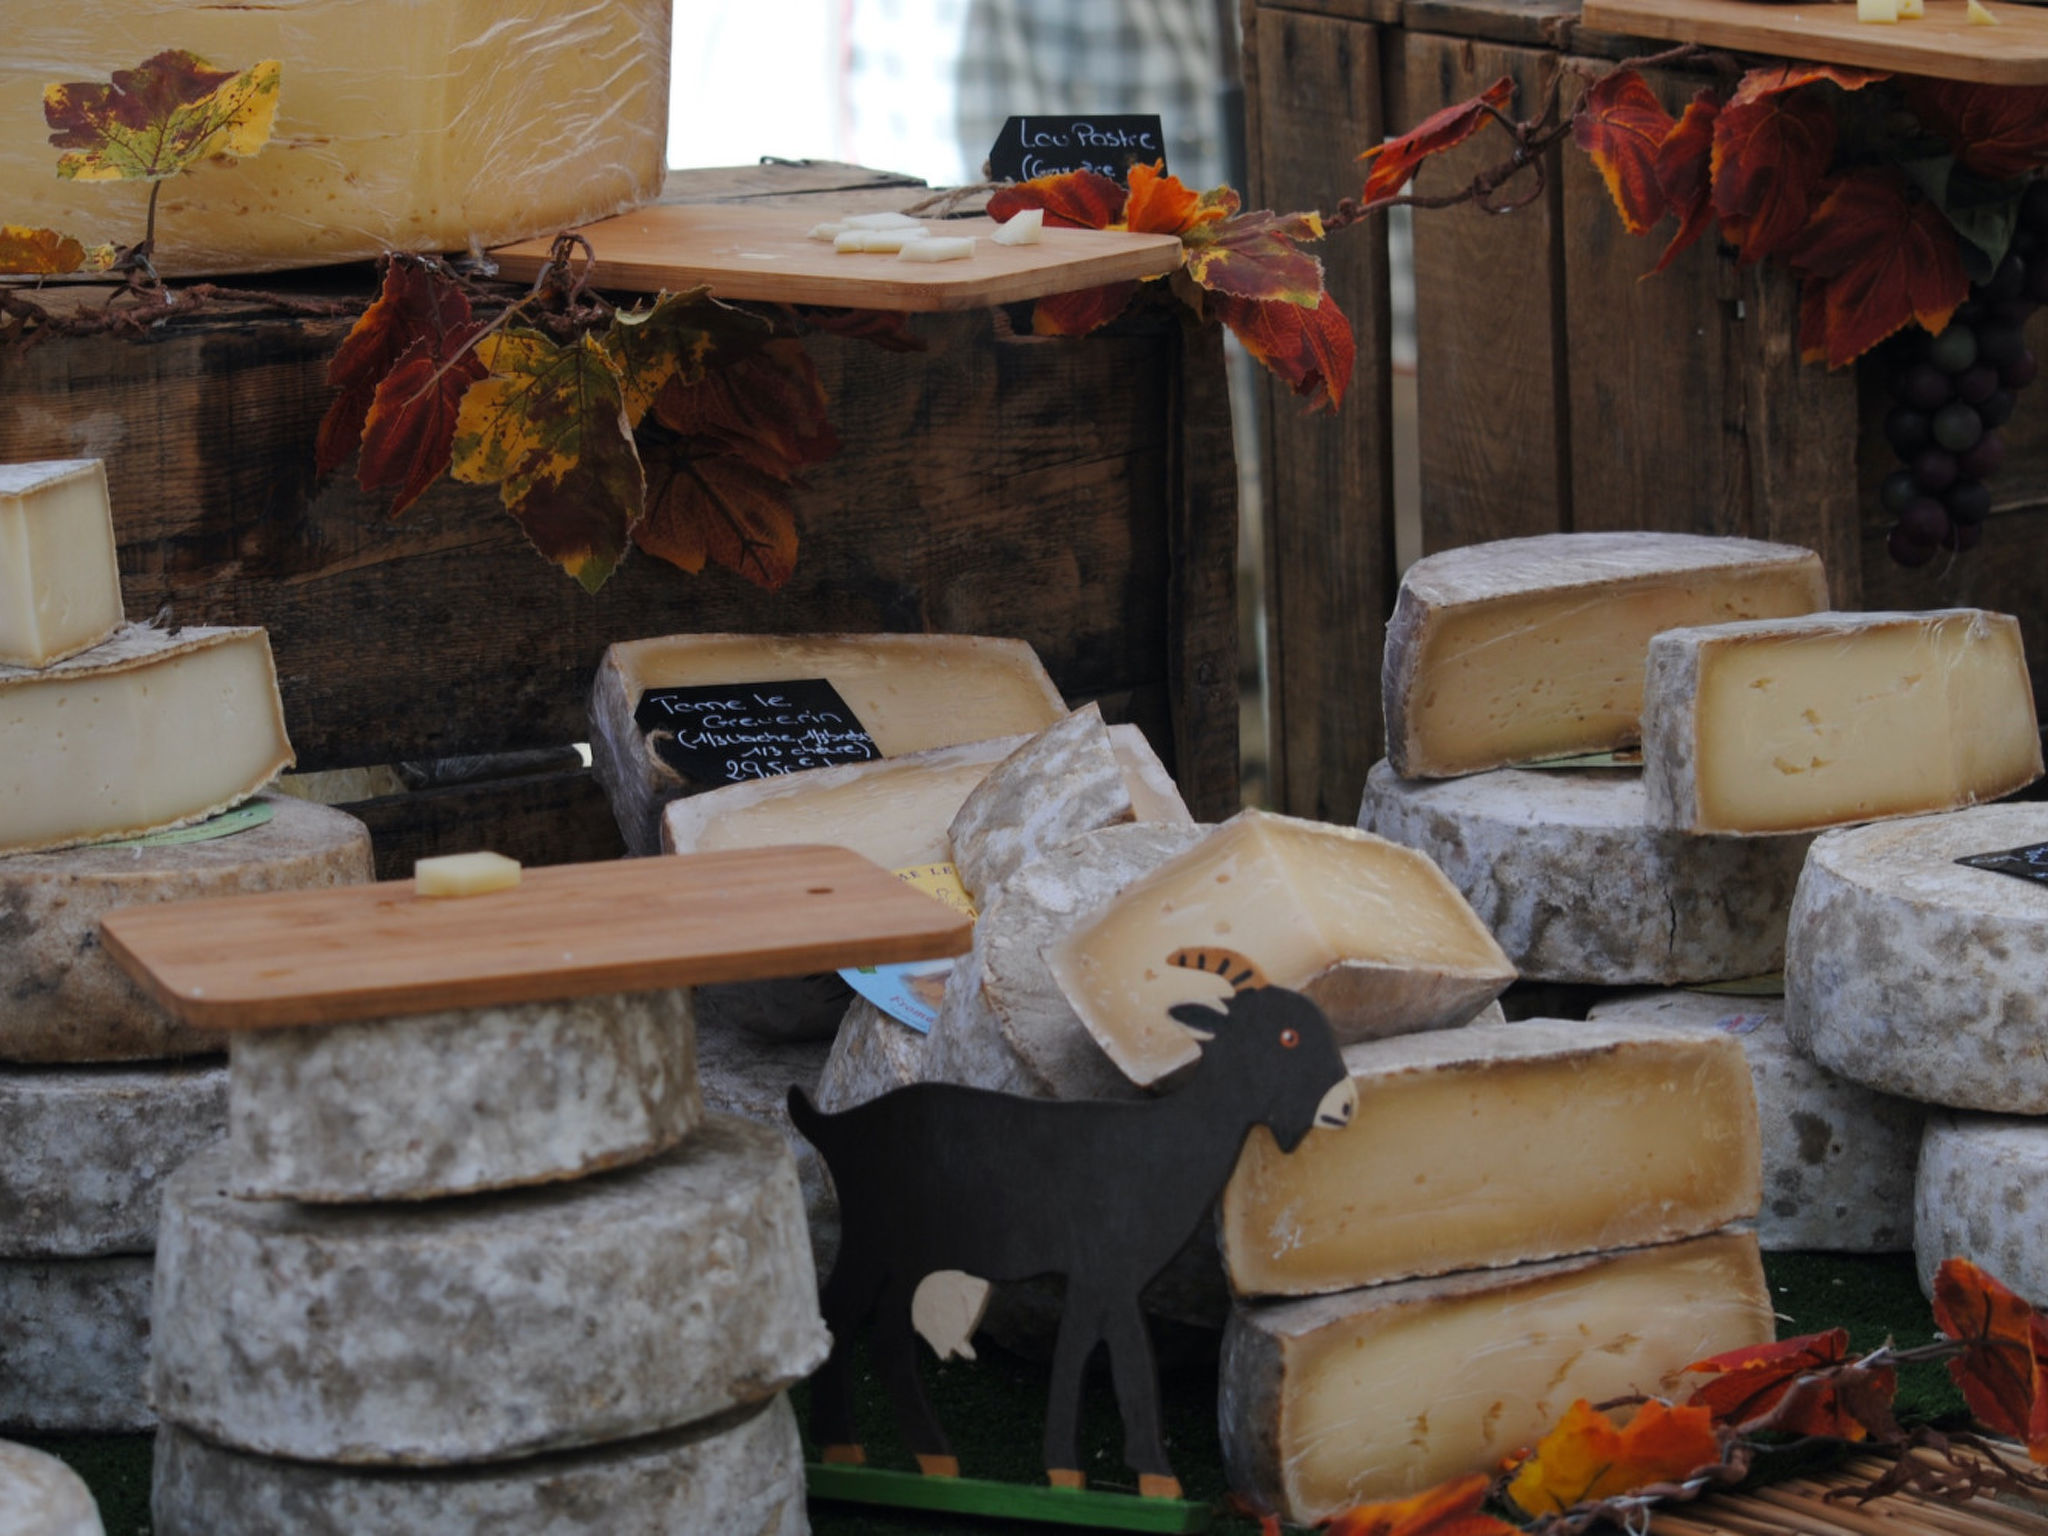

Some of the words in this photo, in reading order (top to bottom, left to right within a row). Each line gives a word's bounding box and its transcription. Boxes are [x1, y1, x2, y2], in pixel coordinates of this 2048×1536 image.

[1021, 119, 1069, 148] Lou
[1071, 122, 1156, 149] Pastre
[753, 694, 792, 708] le
[741, 747, 782, 758] 1/3
